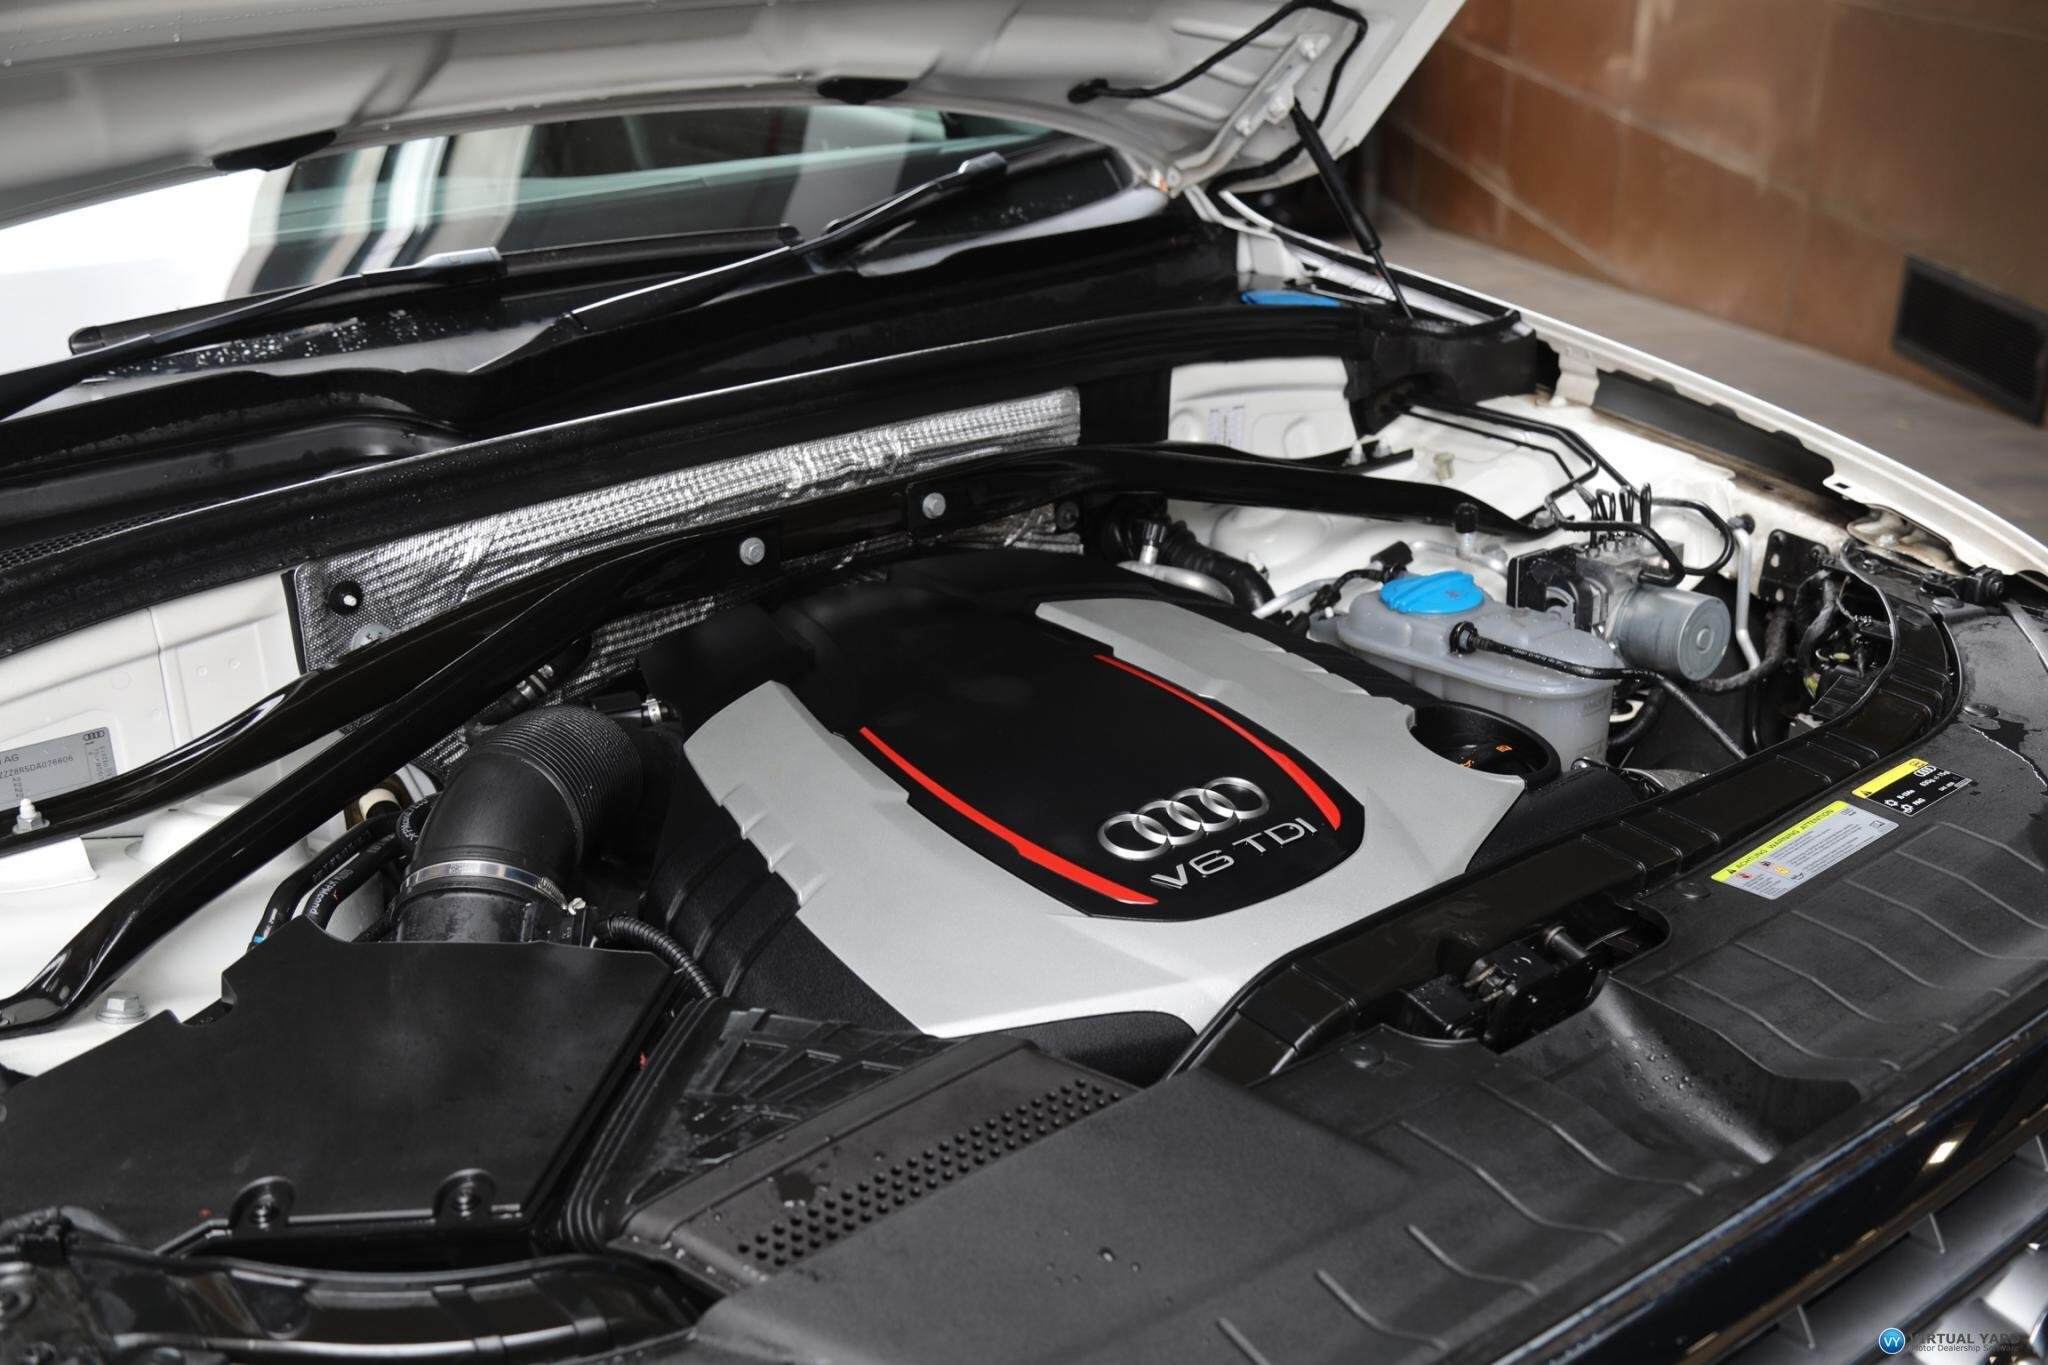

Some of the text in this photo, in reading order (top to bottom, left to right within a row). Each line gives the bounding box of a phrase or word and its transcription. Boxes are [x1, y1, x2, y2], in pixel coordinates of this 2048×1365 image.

[4, 754, 19, 763] AG
[1800, 809, 1834, 830] ATTENTION
[1150, 817, 1318, 889] V6 TDI
